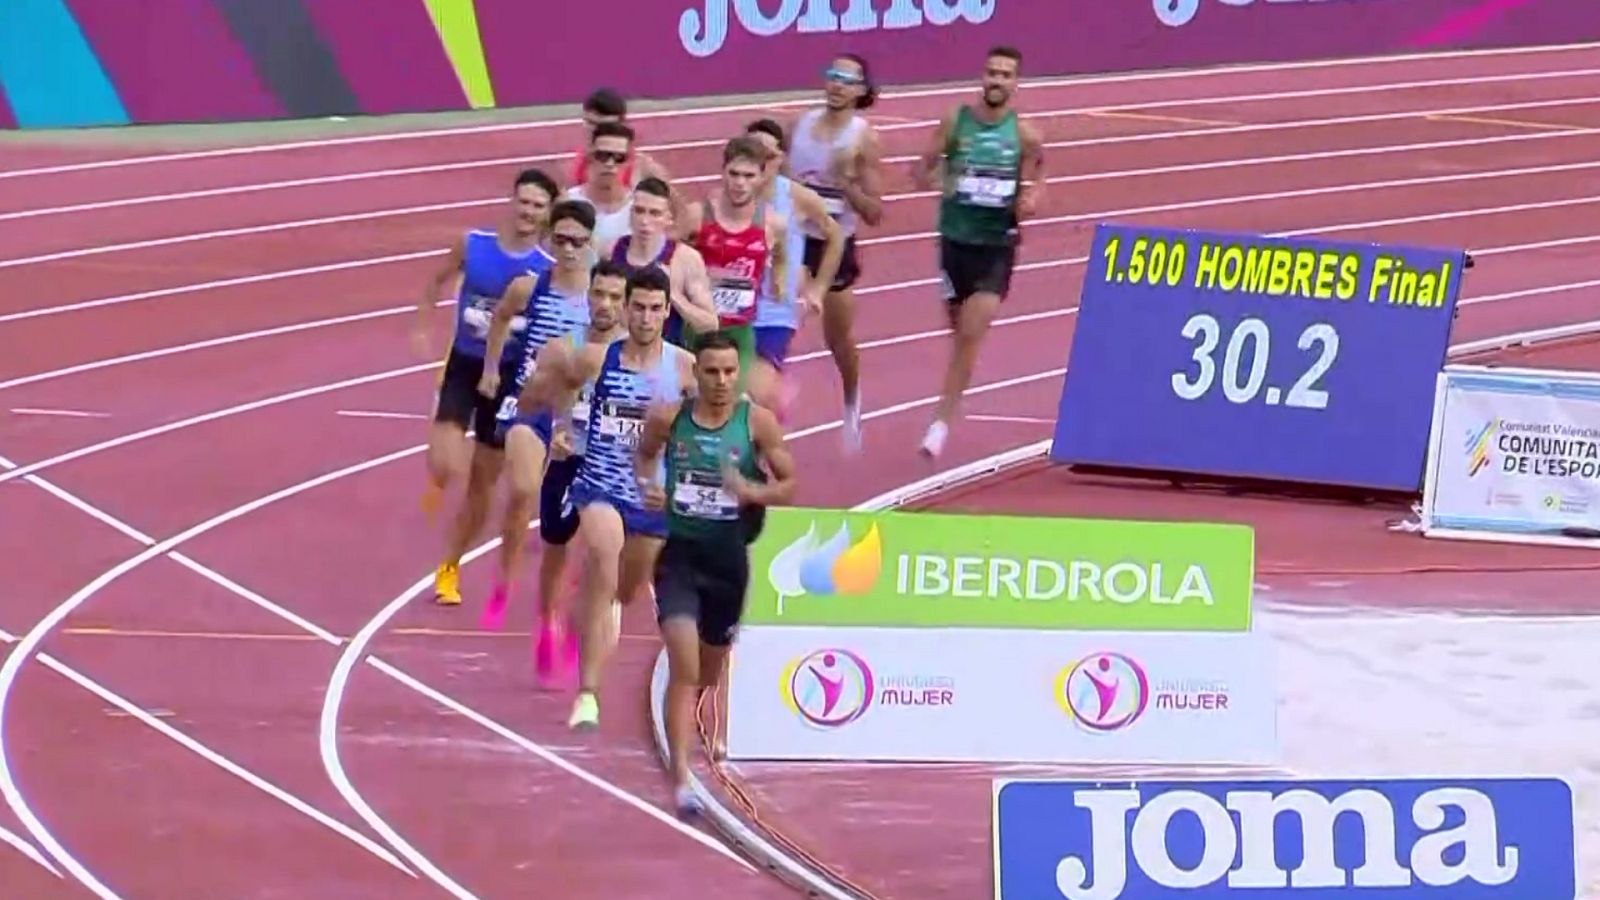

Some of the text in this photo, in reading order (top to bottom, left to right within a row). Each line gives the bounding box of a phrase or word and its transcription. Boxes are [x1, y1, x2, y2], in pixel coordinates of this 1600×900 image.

[1104, 239, 1450, 308] 1.500 HOMBRES Final
[1171, 314, 1340, 409] 30.2
[1553, 424, 1600, 439] Valencia
[1499, 434, 1600, 459] COMUNITA
[1503, 455, 1530, 474] DE
[896, 553, 1215, 606] IBERDROLA
[880, 689, 954, 706] MUJER
[1156, 693, 1229, 710] MUJER
